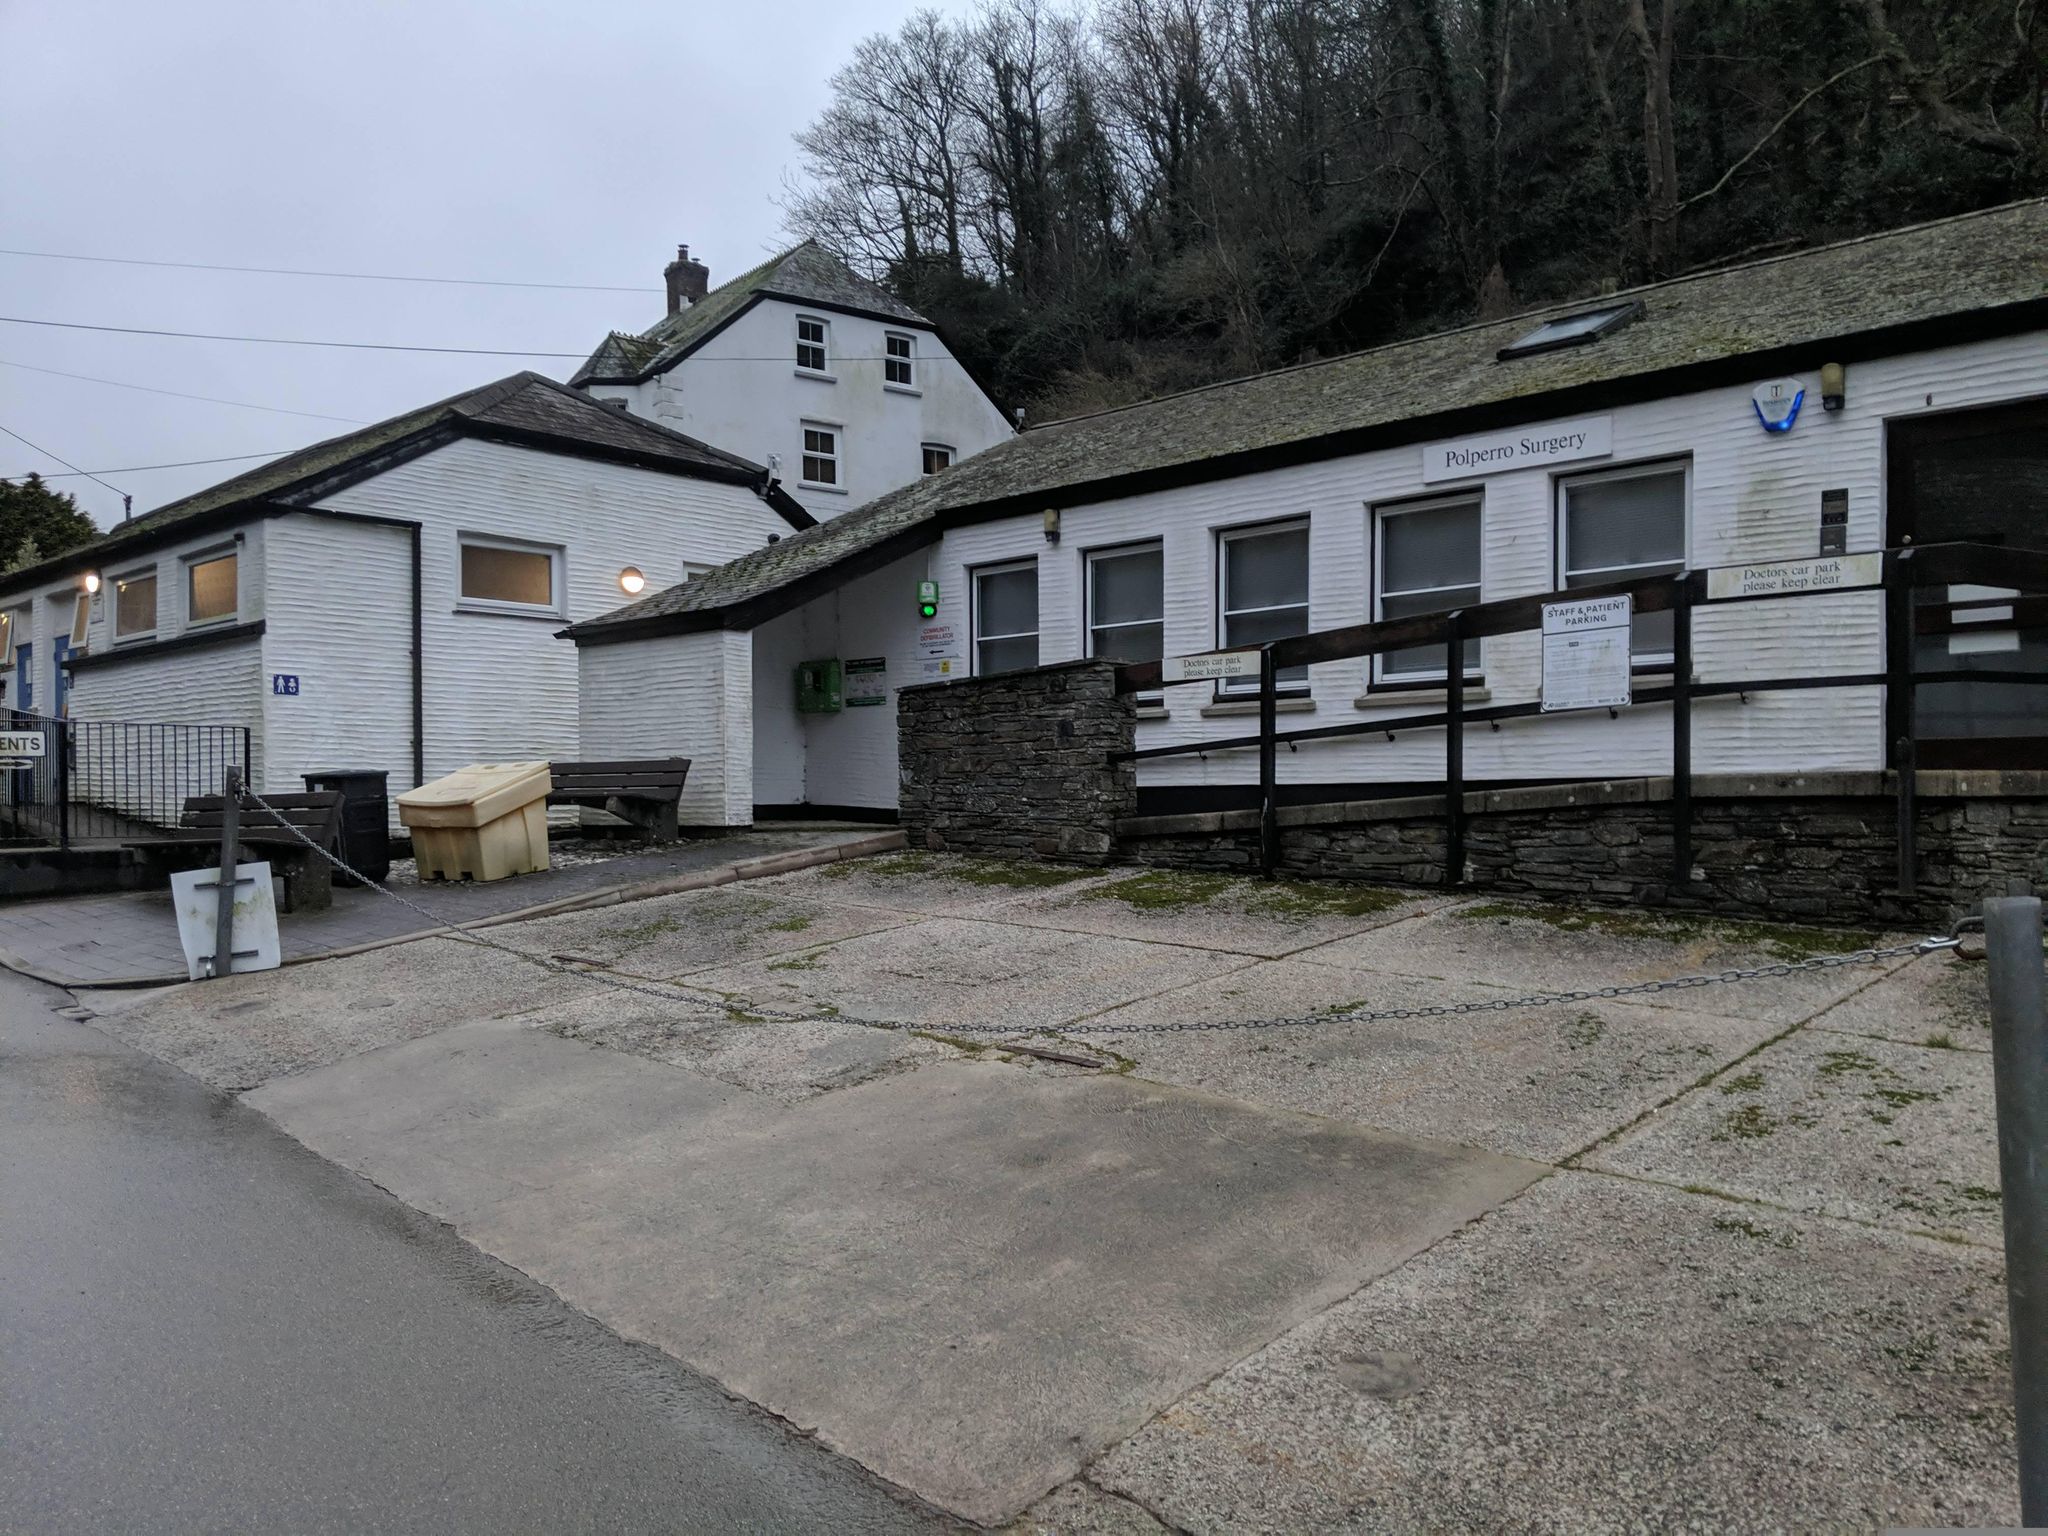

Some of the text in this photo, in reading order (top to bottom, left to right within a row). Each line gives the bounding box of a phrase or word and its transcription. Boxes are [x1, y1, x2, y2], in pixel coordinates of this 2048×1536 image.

[1446, 433, 1587, 467] Polperro Surgery
[1744, 561, 1841, 580] Doctors car park
[1743, 574, 1841, 593] please keep clear
[1548, 601, 1626, 618] STAFF & PATIENT
[1565, 614, 1608, 625] PARKING
[1183, 656, 1242, 668] Doctors car park
[1184, 666, 1242, 678] please keep clear
